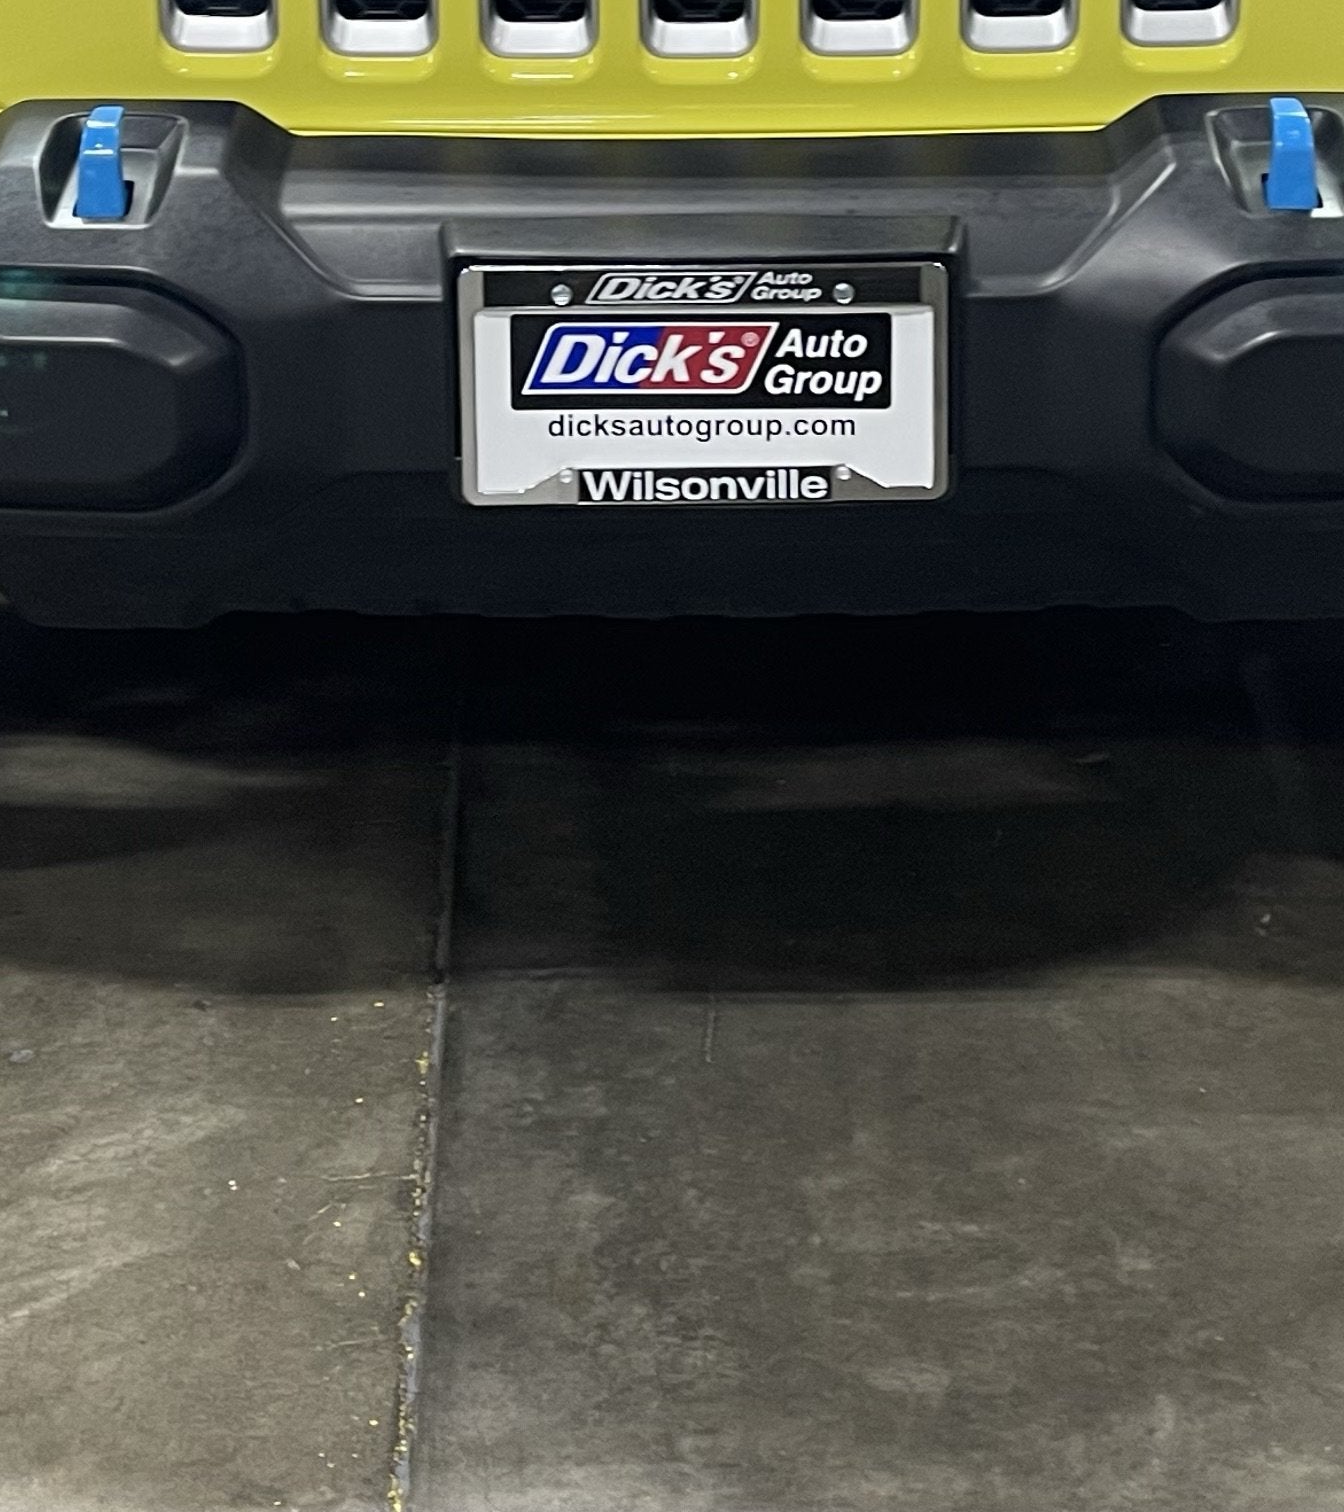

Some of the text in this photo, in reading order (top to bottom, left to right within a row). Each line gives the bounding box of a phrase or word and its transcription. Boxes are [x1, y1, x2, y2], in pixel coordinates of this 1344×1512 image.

[597, 276, 736, 300] Dick's
[756, 271, 813, 285] Auto
[750, 286, 822, 302] Group
[539, 330, 746, 384] Dick's
[775, 328, 868, 359] Auto
[764, 365, 883, 402] Group
[548, 414, 856, 442] dicksautogroup.com
[580, 468, 829, 501] Wilsonville
